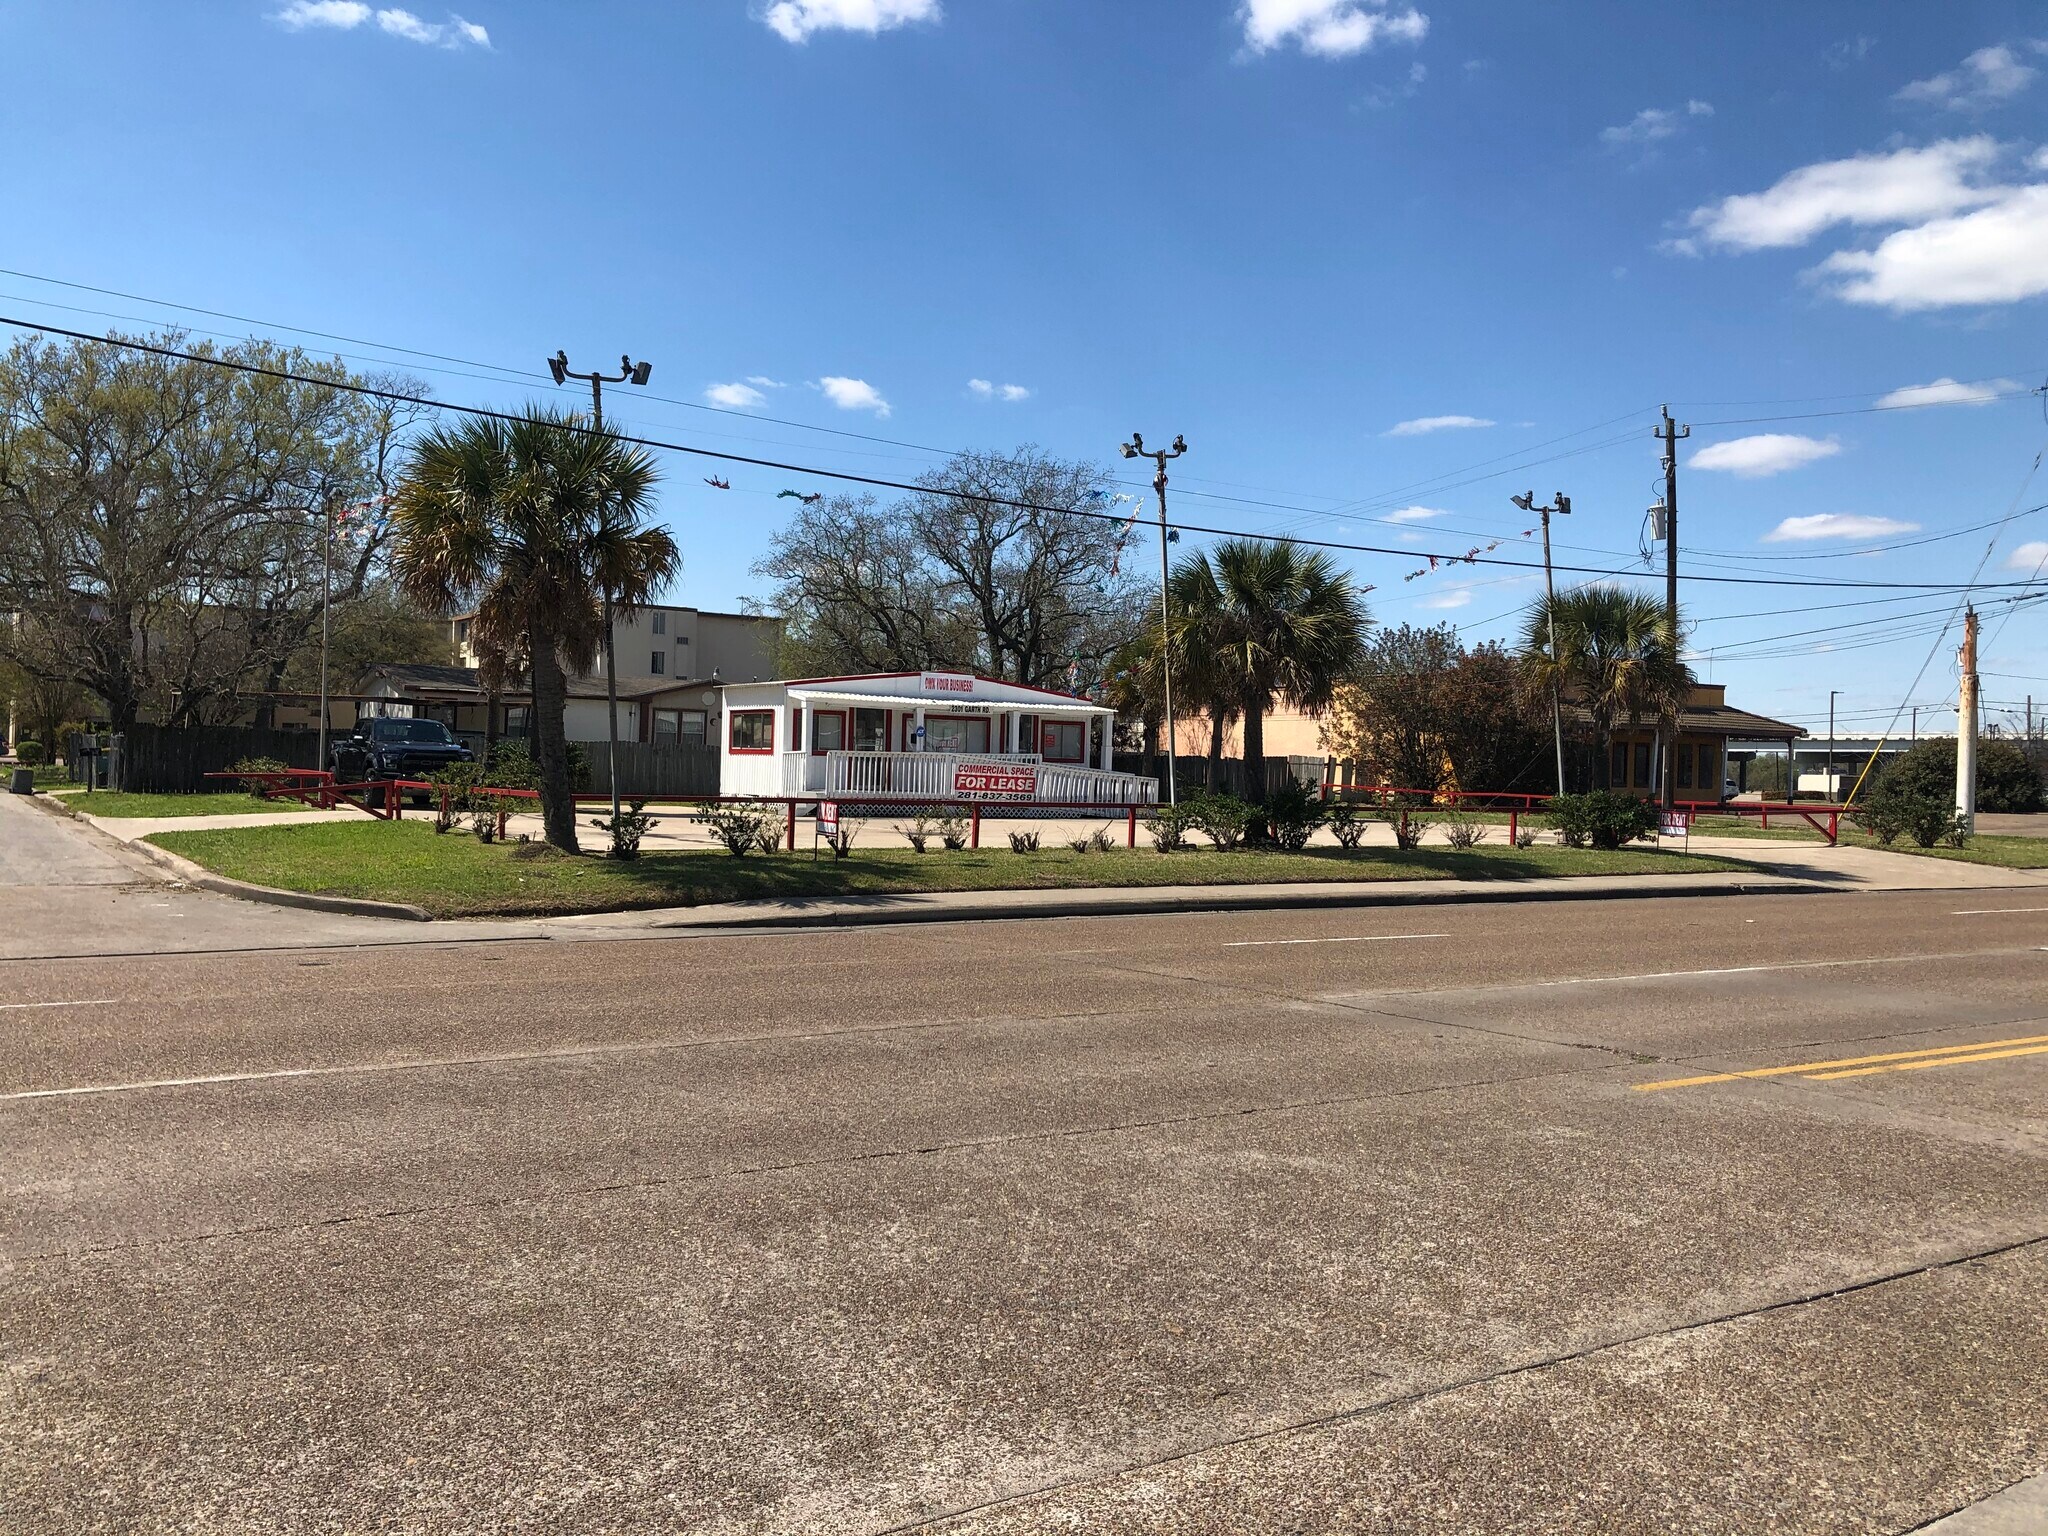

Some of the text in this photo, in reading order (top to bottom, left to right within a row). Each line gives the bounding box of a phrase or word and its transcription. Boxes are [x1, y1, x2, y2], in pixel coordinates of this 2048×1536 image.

[937, 678, 949, 691] YOUR
[951, 705, 963, 713] 2301
[964, 705, 981, 713] GARTH
[958, 764, 1035, 776] COMMERCIAL SPACE
[956, 776, 1034, 791] FOR LEASE
[957, 791, 1032, 801] 281-837-3569
